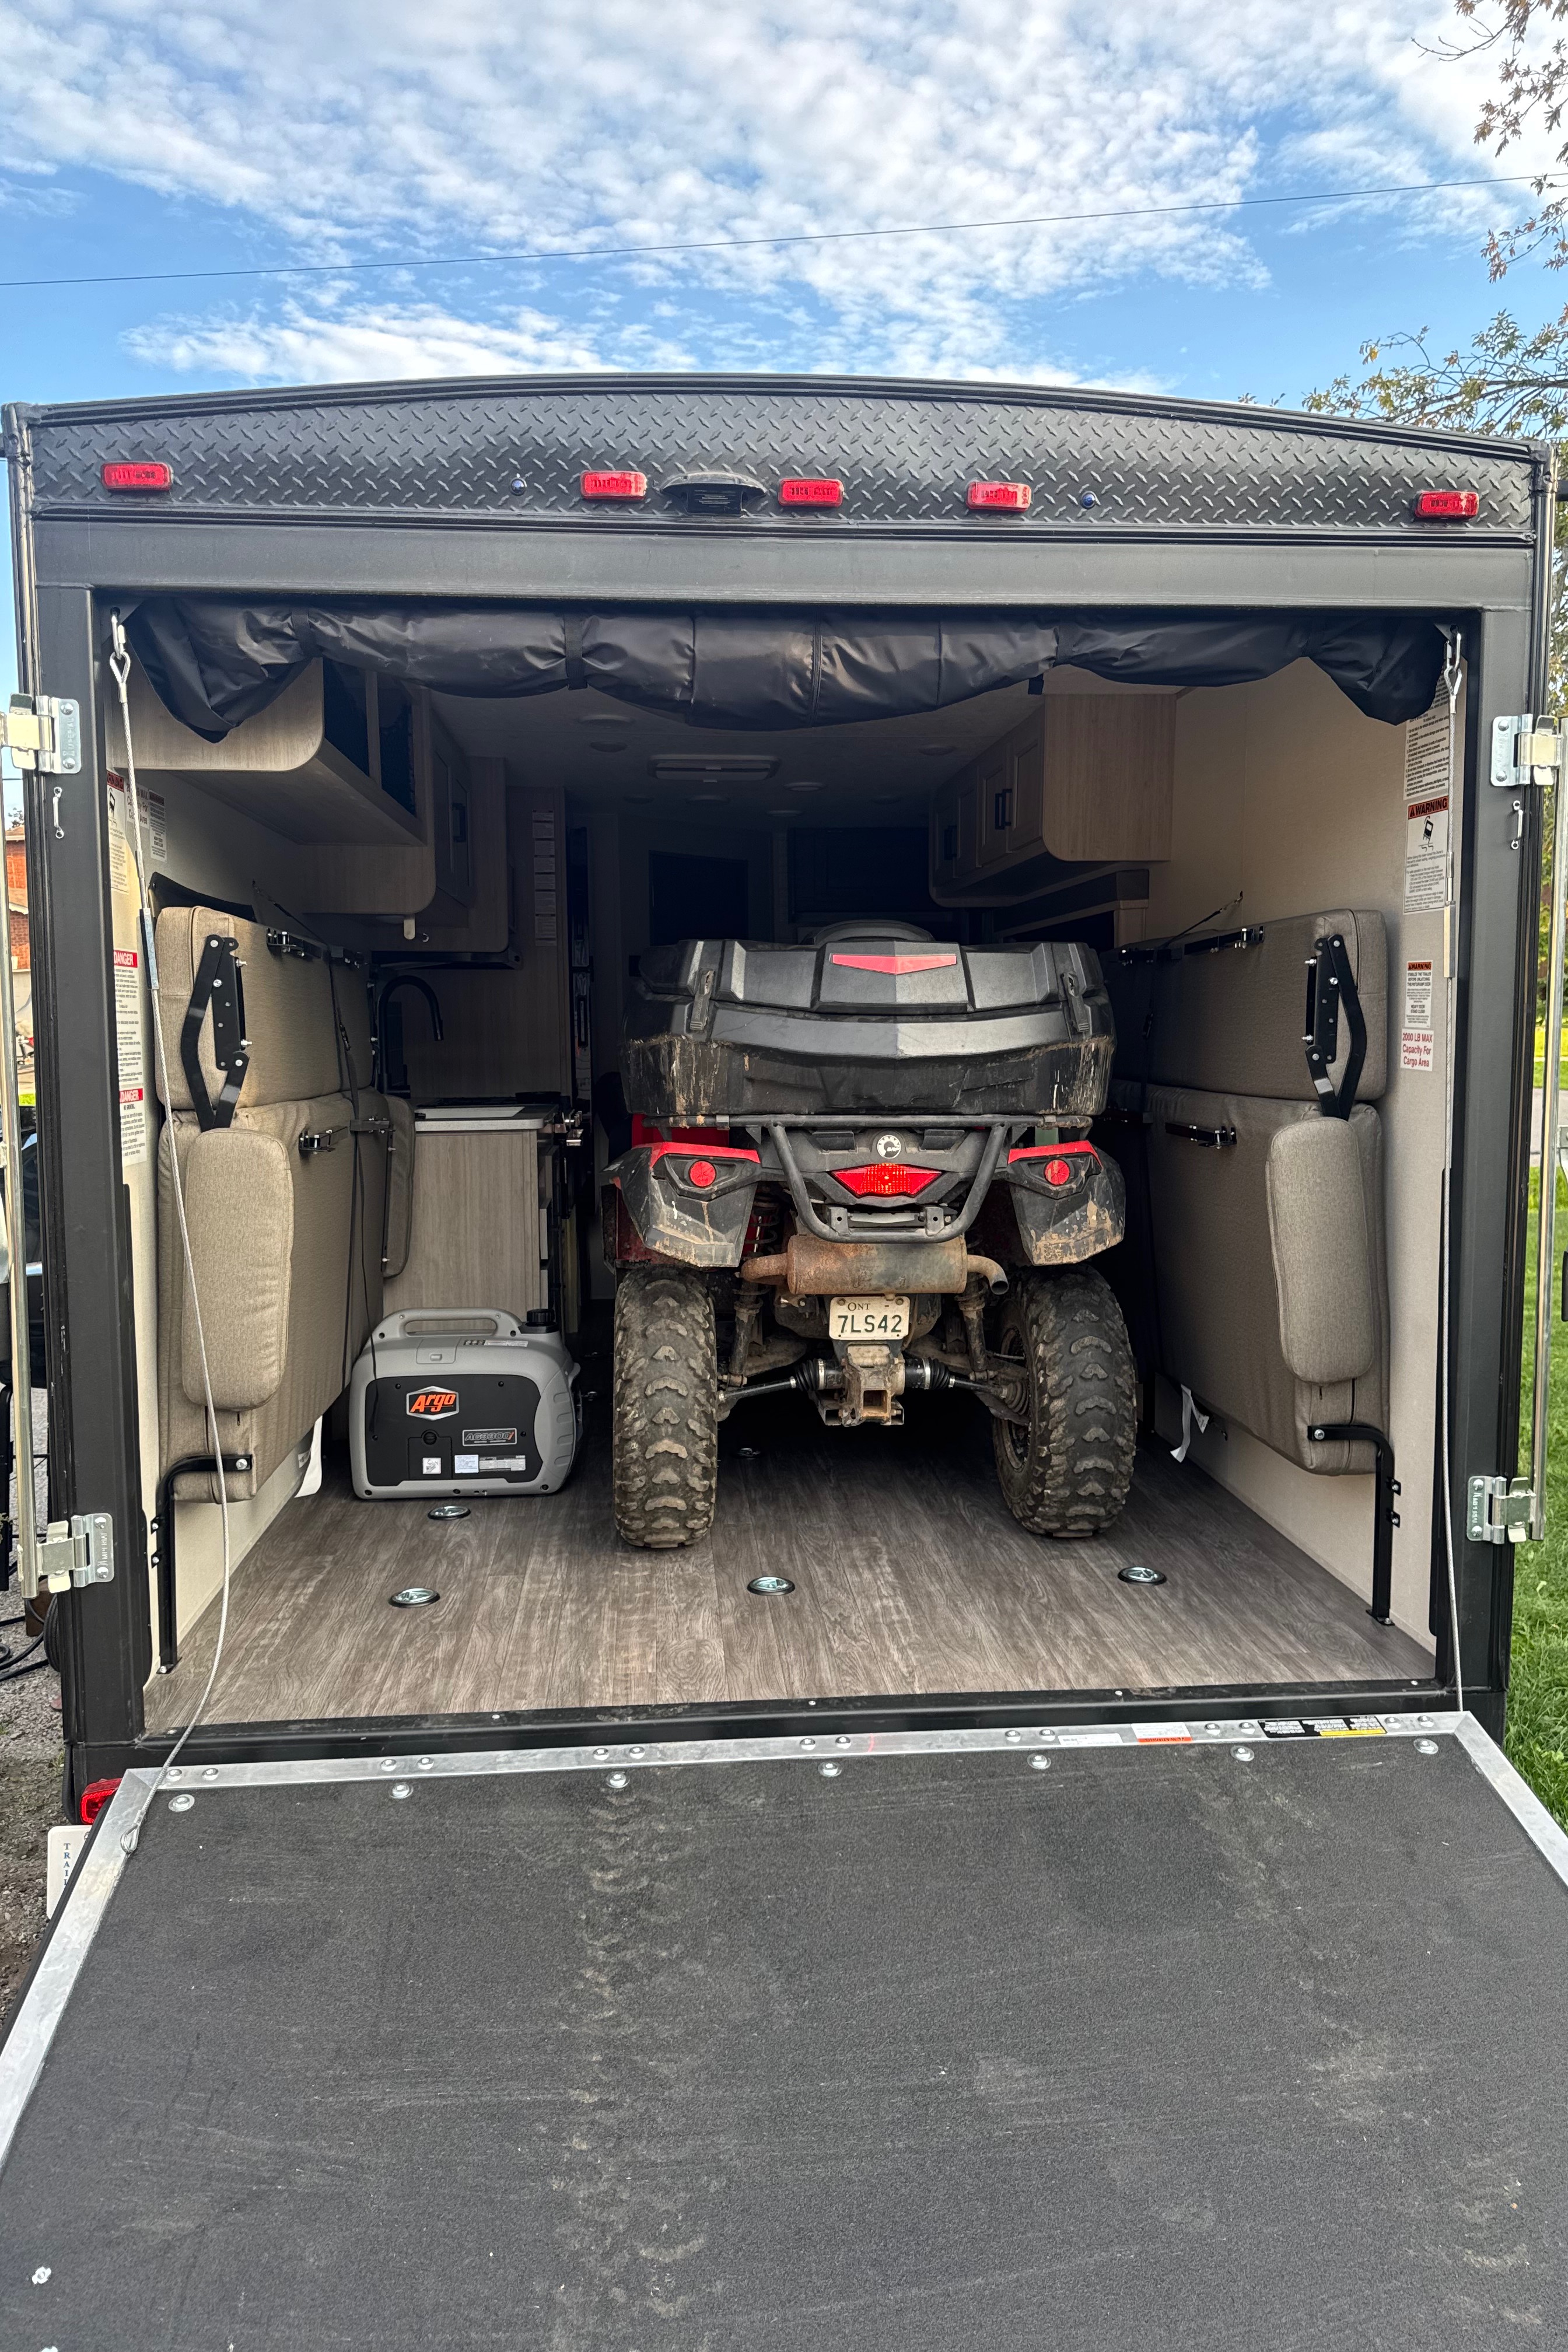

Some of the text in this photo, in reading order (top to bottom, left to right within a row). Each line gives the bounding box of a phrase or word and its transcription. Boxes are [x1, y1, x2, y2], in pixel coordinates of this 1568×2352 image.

[1416, 798, 1447, 815] WARNING
[114, 951, 134, 966] DANGER
[1402, 1032, 1433, 1042] 2000 LB MAX
[1402, 1044, 1432, 1056] Capacity For
[1404, 1056, 1429, 1068] Cargo Area
[121, 1089, 139, 1102] DANGER
[838, 1314, 902, 1334] 7LS42
[410, 1394, 456, 1412] Argo
